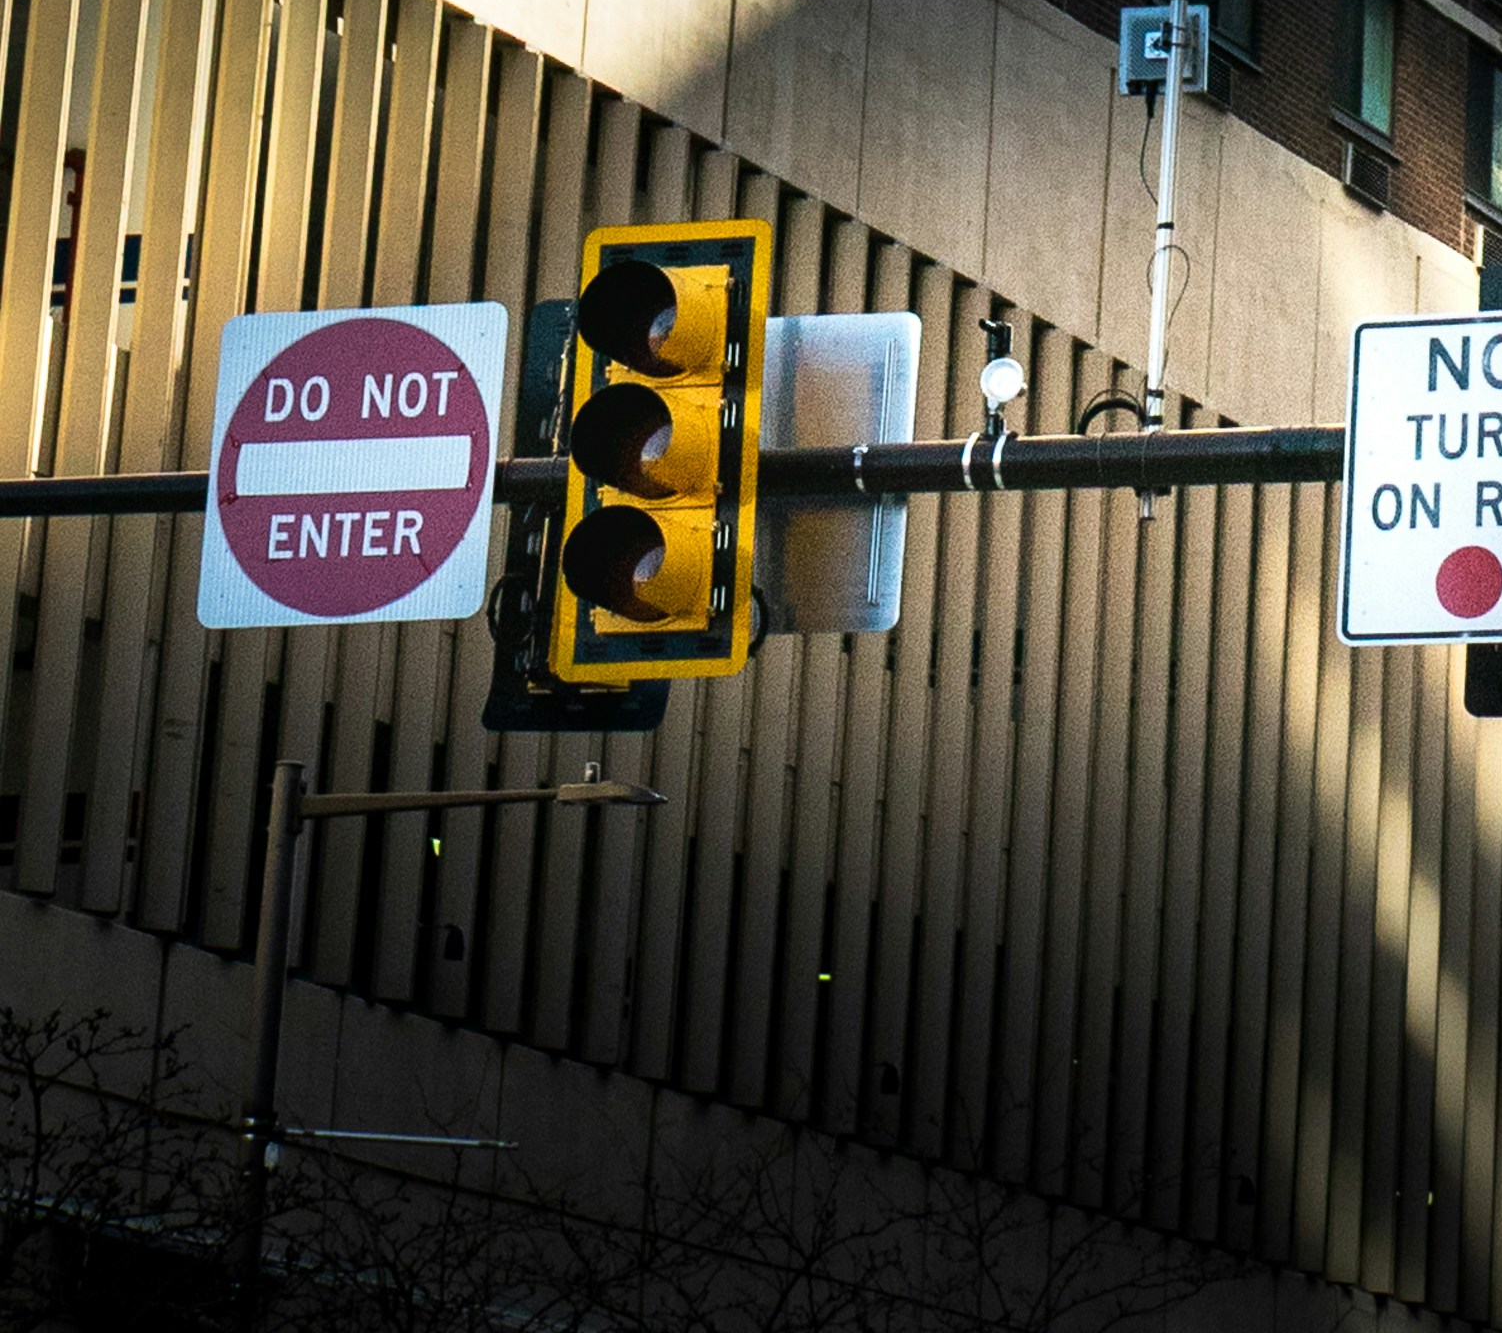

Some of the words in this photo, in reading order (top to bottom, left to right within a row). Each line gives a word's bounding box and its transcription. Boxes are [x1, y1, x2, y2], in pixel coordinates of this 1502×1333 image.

[264, 375, 330, 422] DO
[361, 371, 458, 419] NOT
[1371, 482, 1441, 531] ON
[267, 509, 424, 560] ENTER
